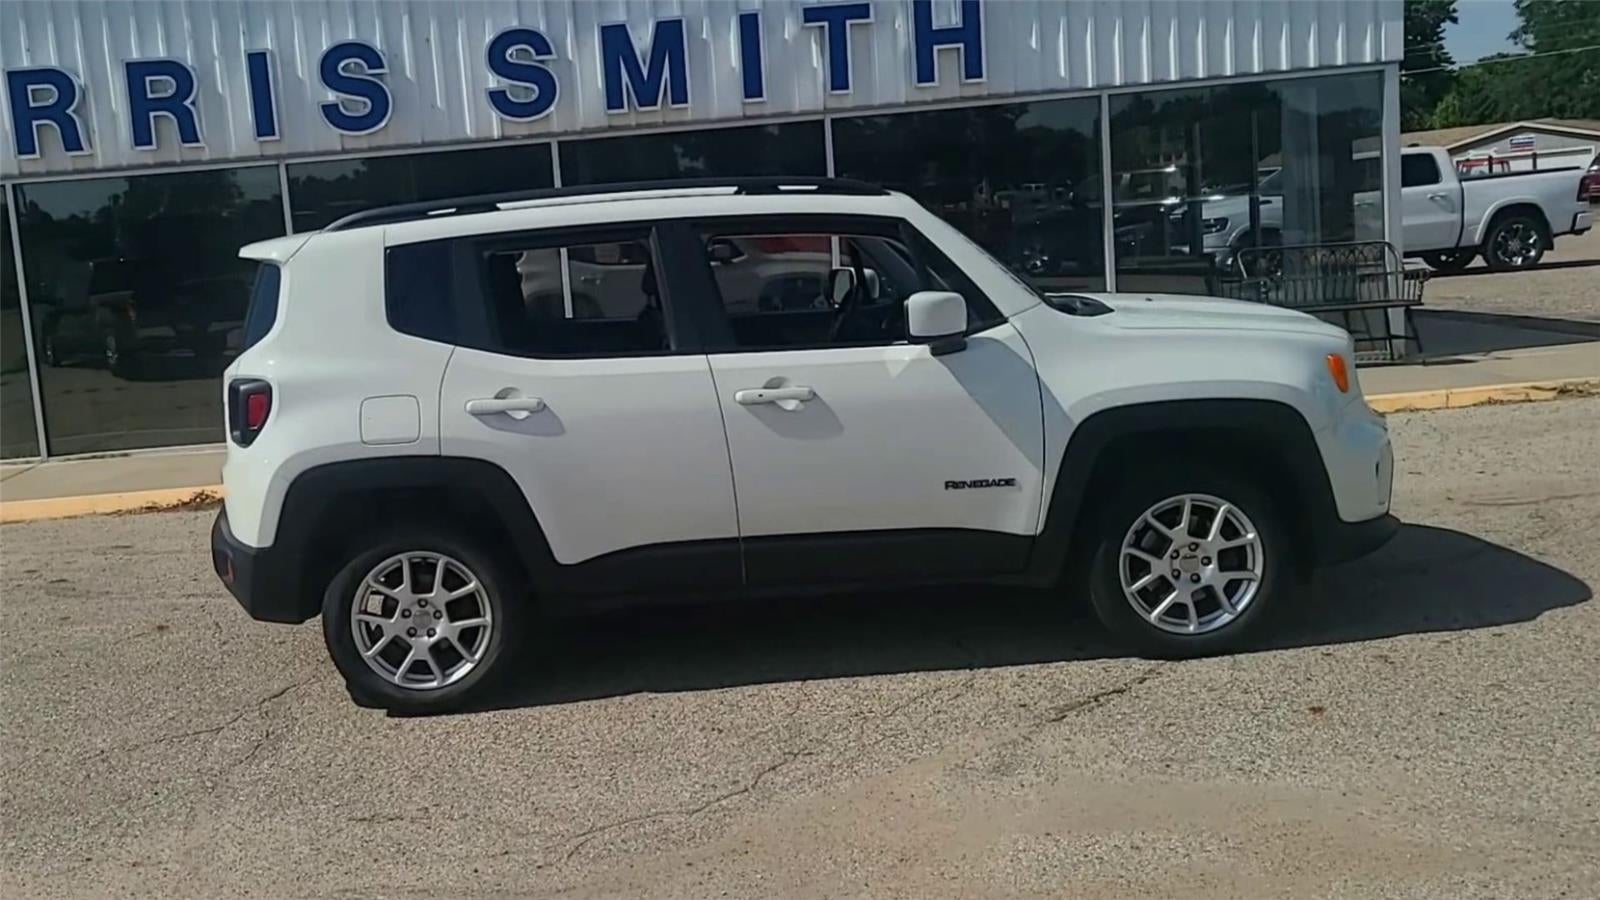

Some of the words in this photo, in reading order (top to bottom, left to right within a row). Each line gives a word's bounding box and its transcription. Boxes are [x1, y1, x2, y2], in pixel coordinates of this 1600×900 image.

[4, 39, 393, 158] RRIS
[486, 0, 987, 122] SMITH
[944, 477, 1017, 491] RENEGADE
